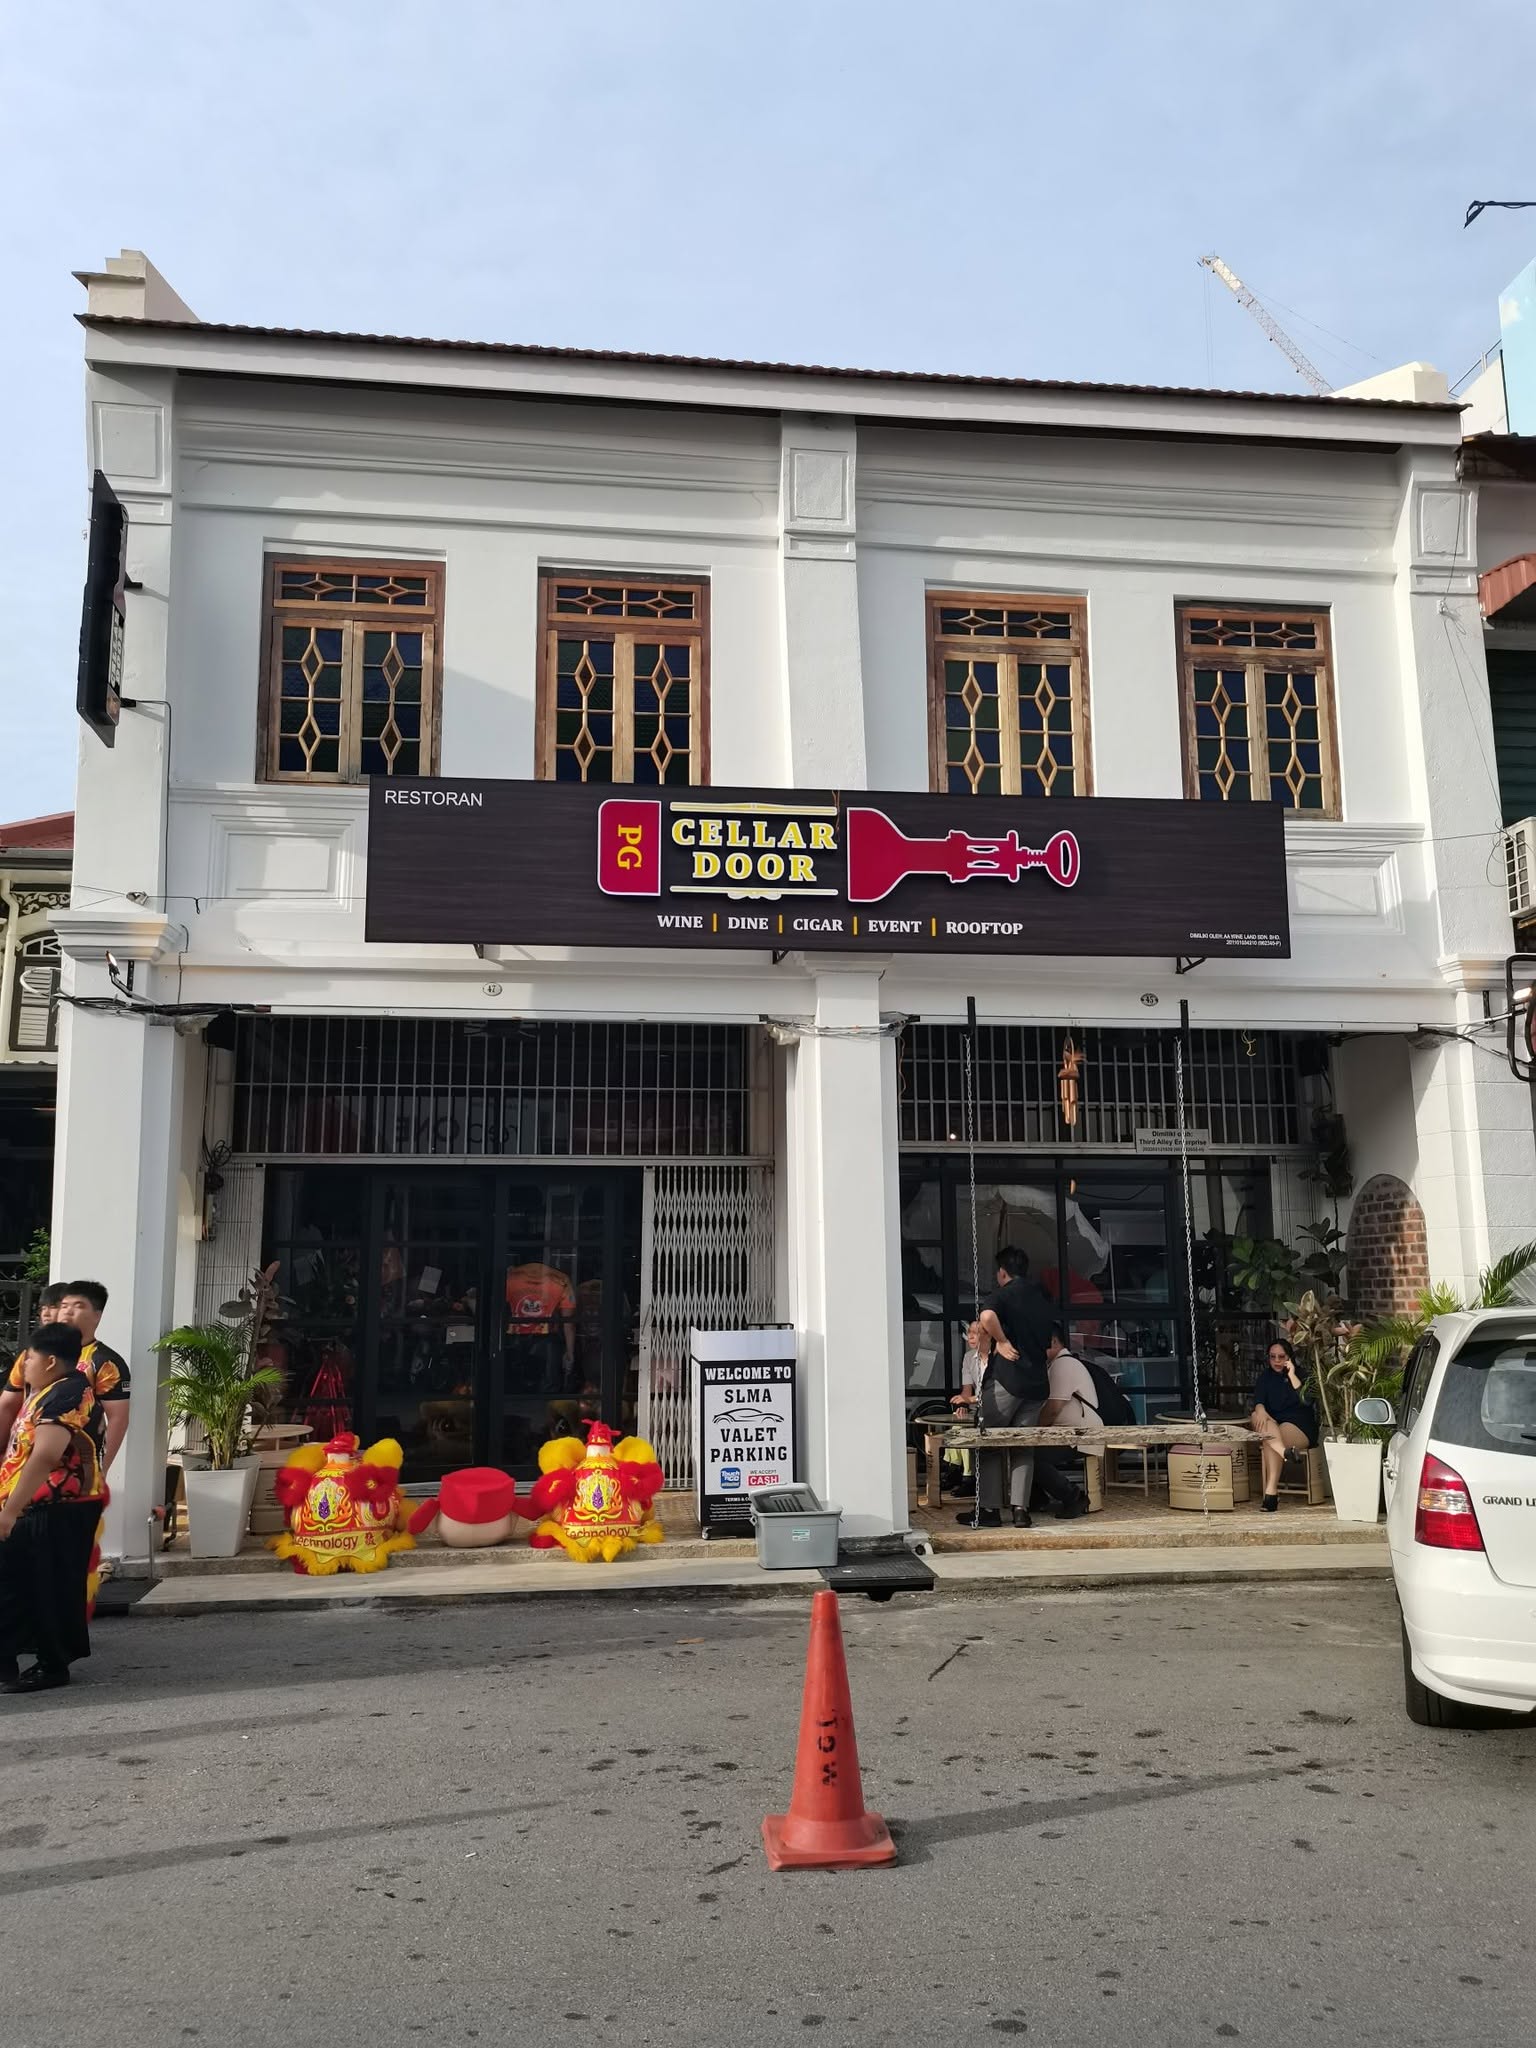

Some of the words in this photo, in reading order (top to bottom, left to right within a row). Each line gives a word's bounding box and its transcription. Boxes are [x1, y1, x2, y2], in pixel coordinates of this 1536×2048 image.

[385, 790, 484, 807] RESTORAN
[671, 817, 839, 850] CELLAR
[616, 823, 643, 870] PG
[692, 851, 818, 883] DOOR
[657, 914, 704, 929] WINE
[727, 916, 769, 930] DINE
[793, 917, 844, 932] CIGAR
[868, 919, 922, 934] EVENT
[946, 920, 1024, 935] ROOFTOP
[704, 1366, 771, 1381] WELCOME
[773, 1366, 792, 1379] TO
[724, 1388, 773, 1404] SLMA
[720, 1427, 777, 1443] VALET
[710, 1446, 788, 1463] PARKING
[750, 1476, 778, 1485] CASH
[1482, 1495, 1522, 1506] GRAND
